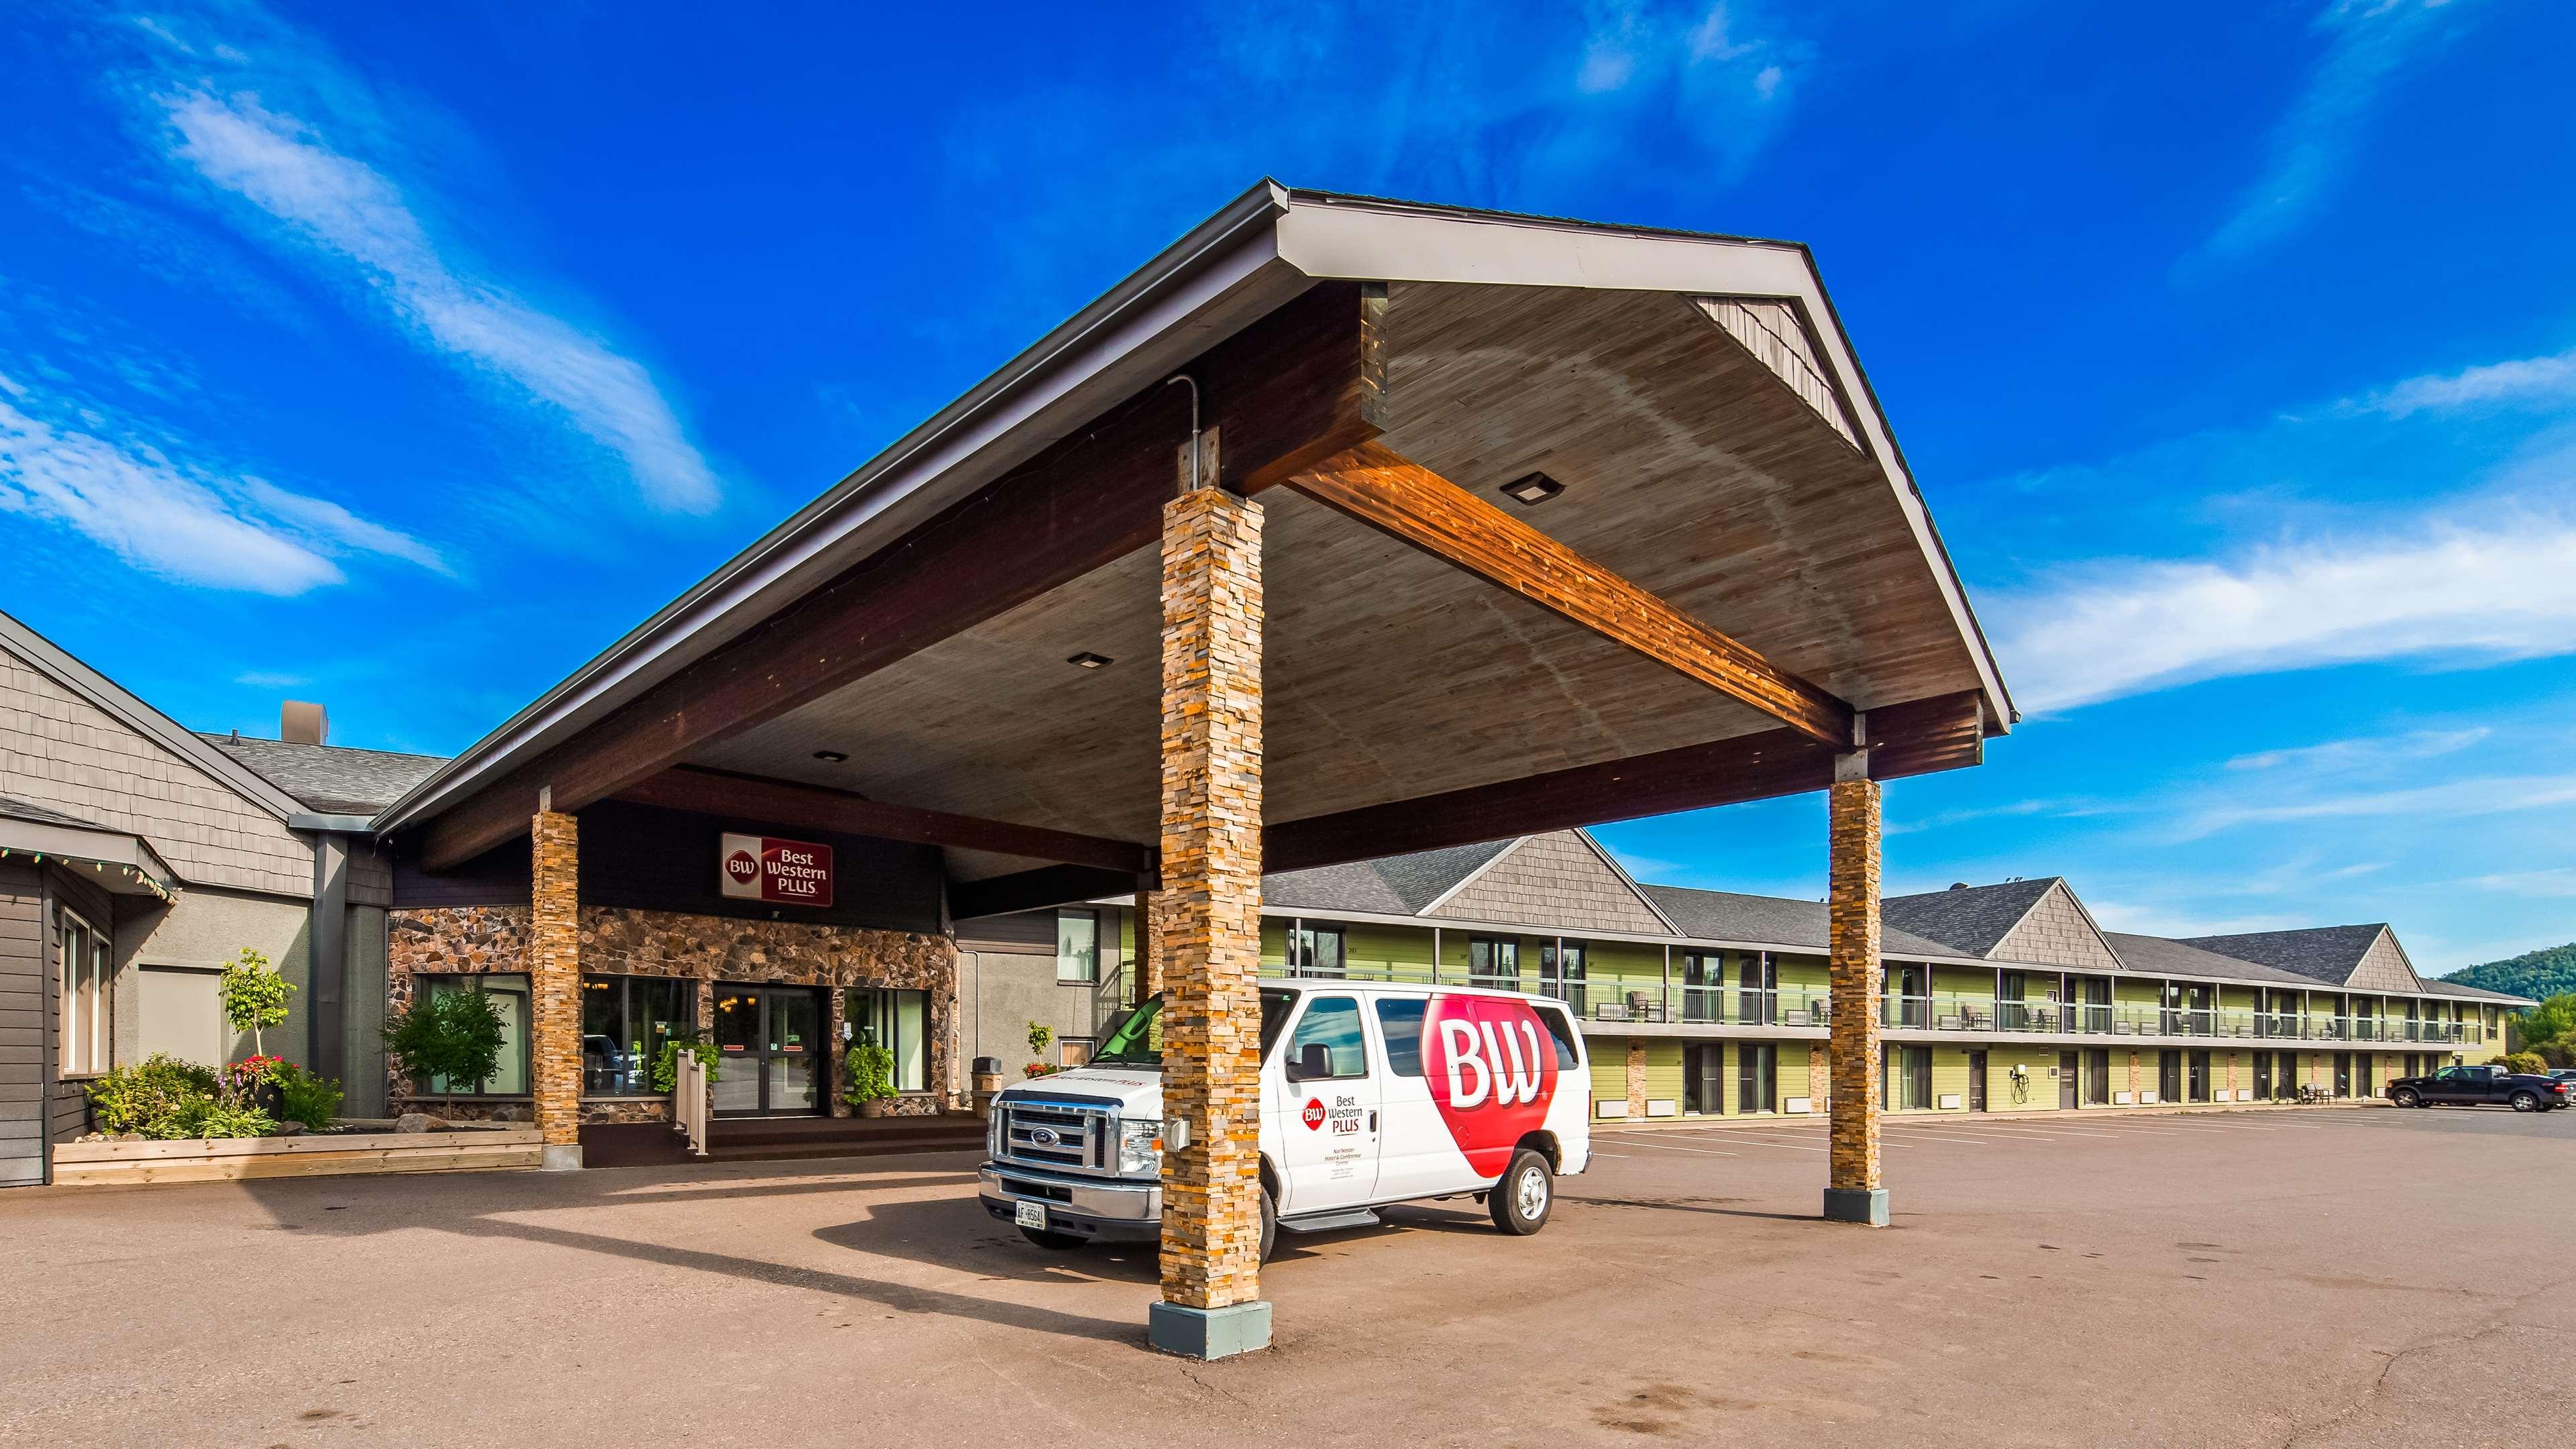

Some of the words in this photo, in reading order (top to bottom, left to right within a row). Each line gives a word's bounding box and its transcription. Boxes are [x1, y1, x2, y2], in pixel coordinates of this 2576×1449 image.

[782, 849, 814, 865] Best
[730, 859, 755, 874] BW
[767, 861, 827, 880] Western
[778, 878, 816, 894] PLUS
[1439, 1019, 1542, 1107] BW
[1336, 1095, 1355, 1107] Best
[1305, 1108, 1324, 1122] BW
[1328, 1108, 1362, 1119] Western
[1333, 1118, 1359, 1133] PLUS
